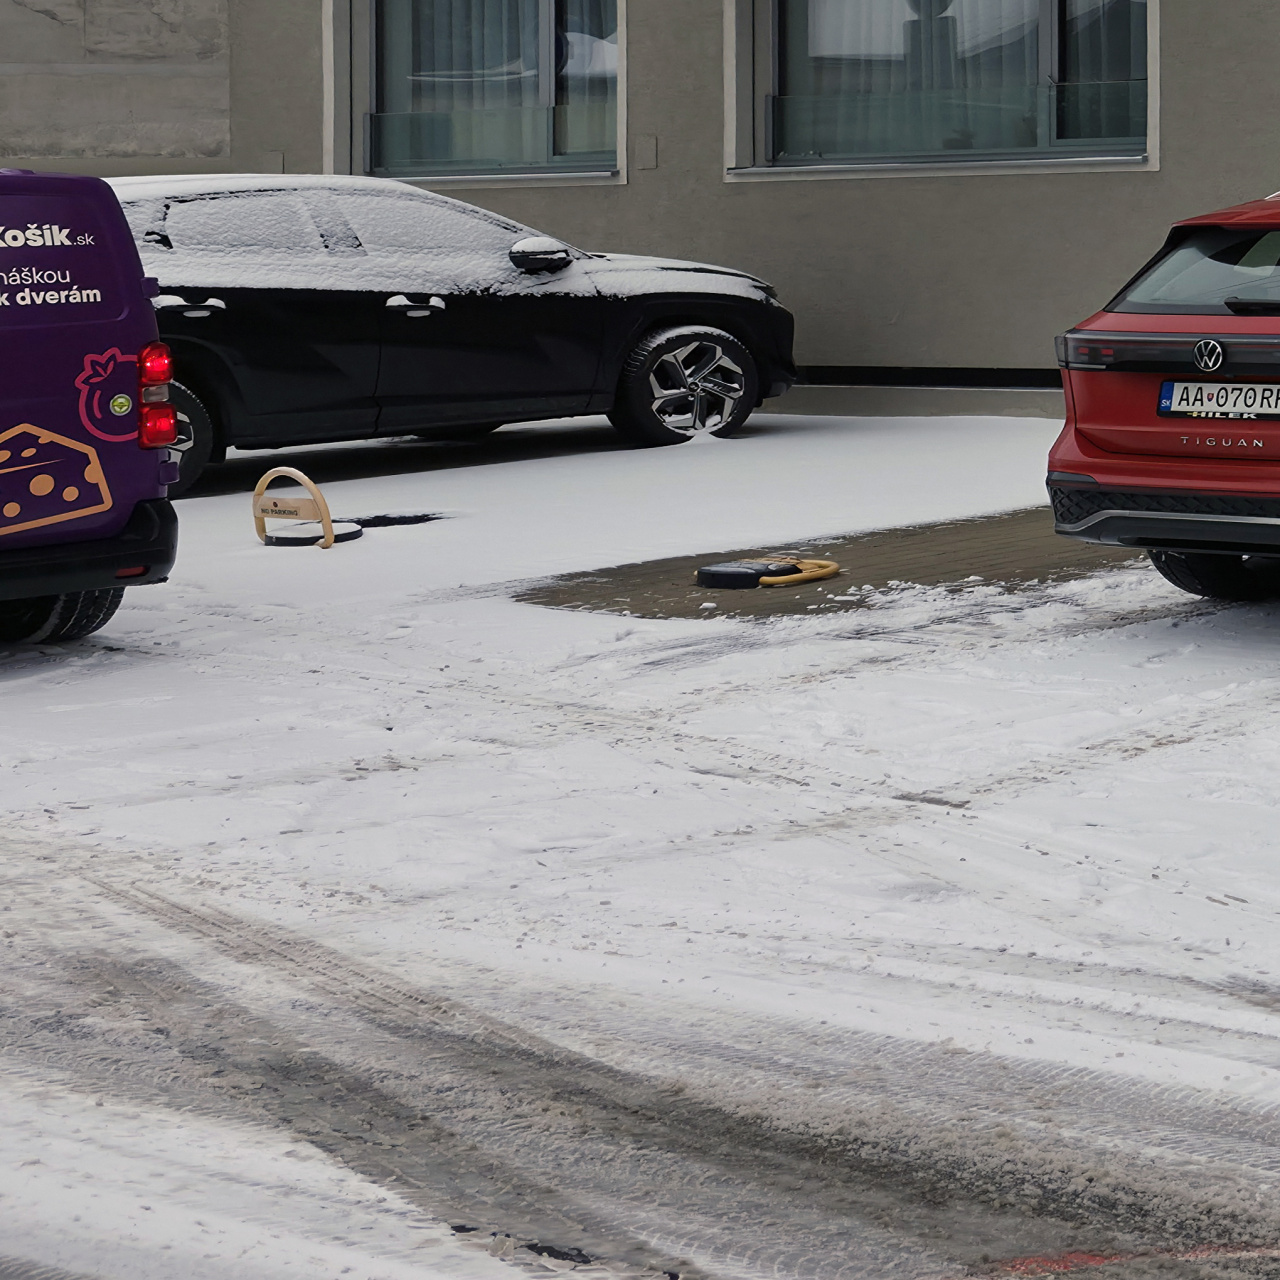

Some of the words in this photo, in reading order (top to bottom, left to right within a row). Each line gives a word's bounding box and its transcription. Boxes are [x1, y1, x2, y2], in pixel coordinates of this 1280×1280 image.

[16, 285, 102, 306] dverám
[1161, 399, 1172, 407] SK
[1180, 436, 1264, 448] TIGUAN
